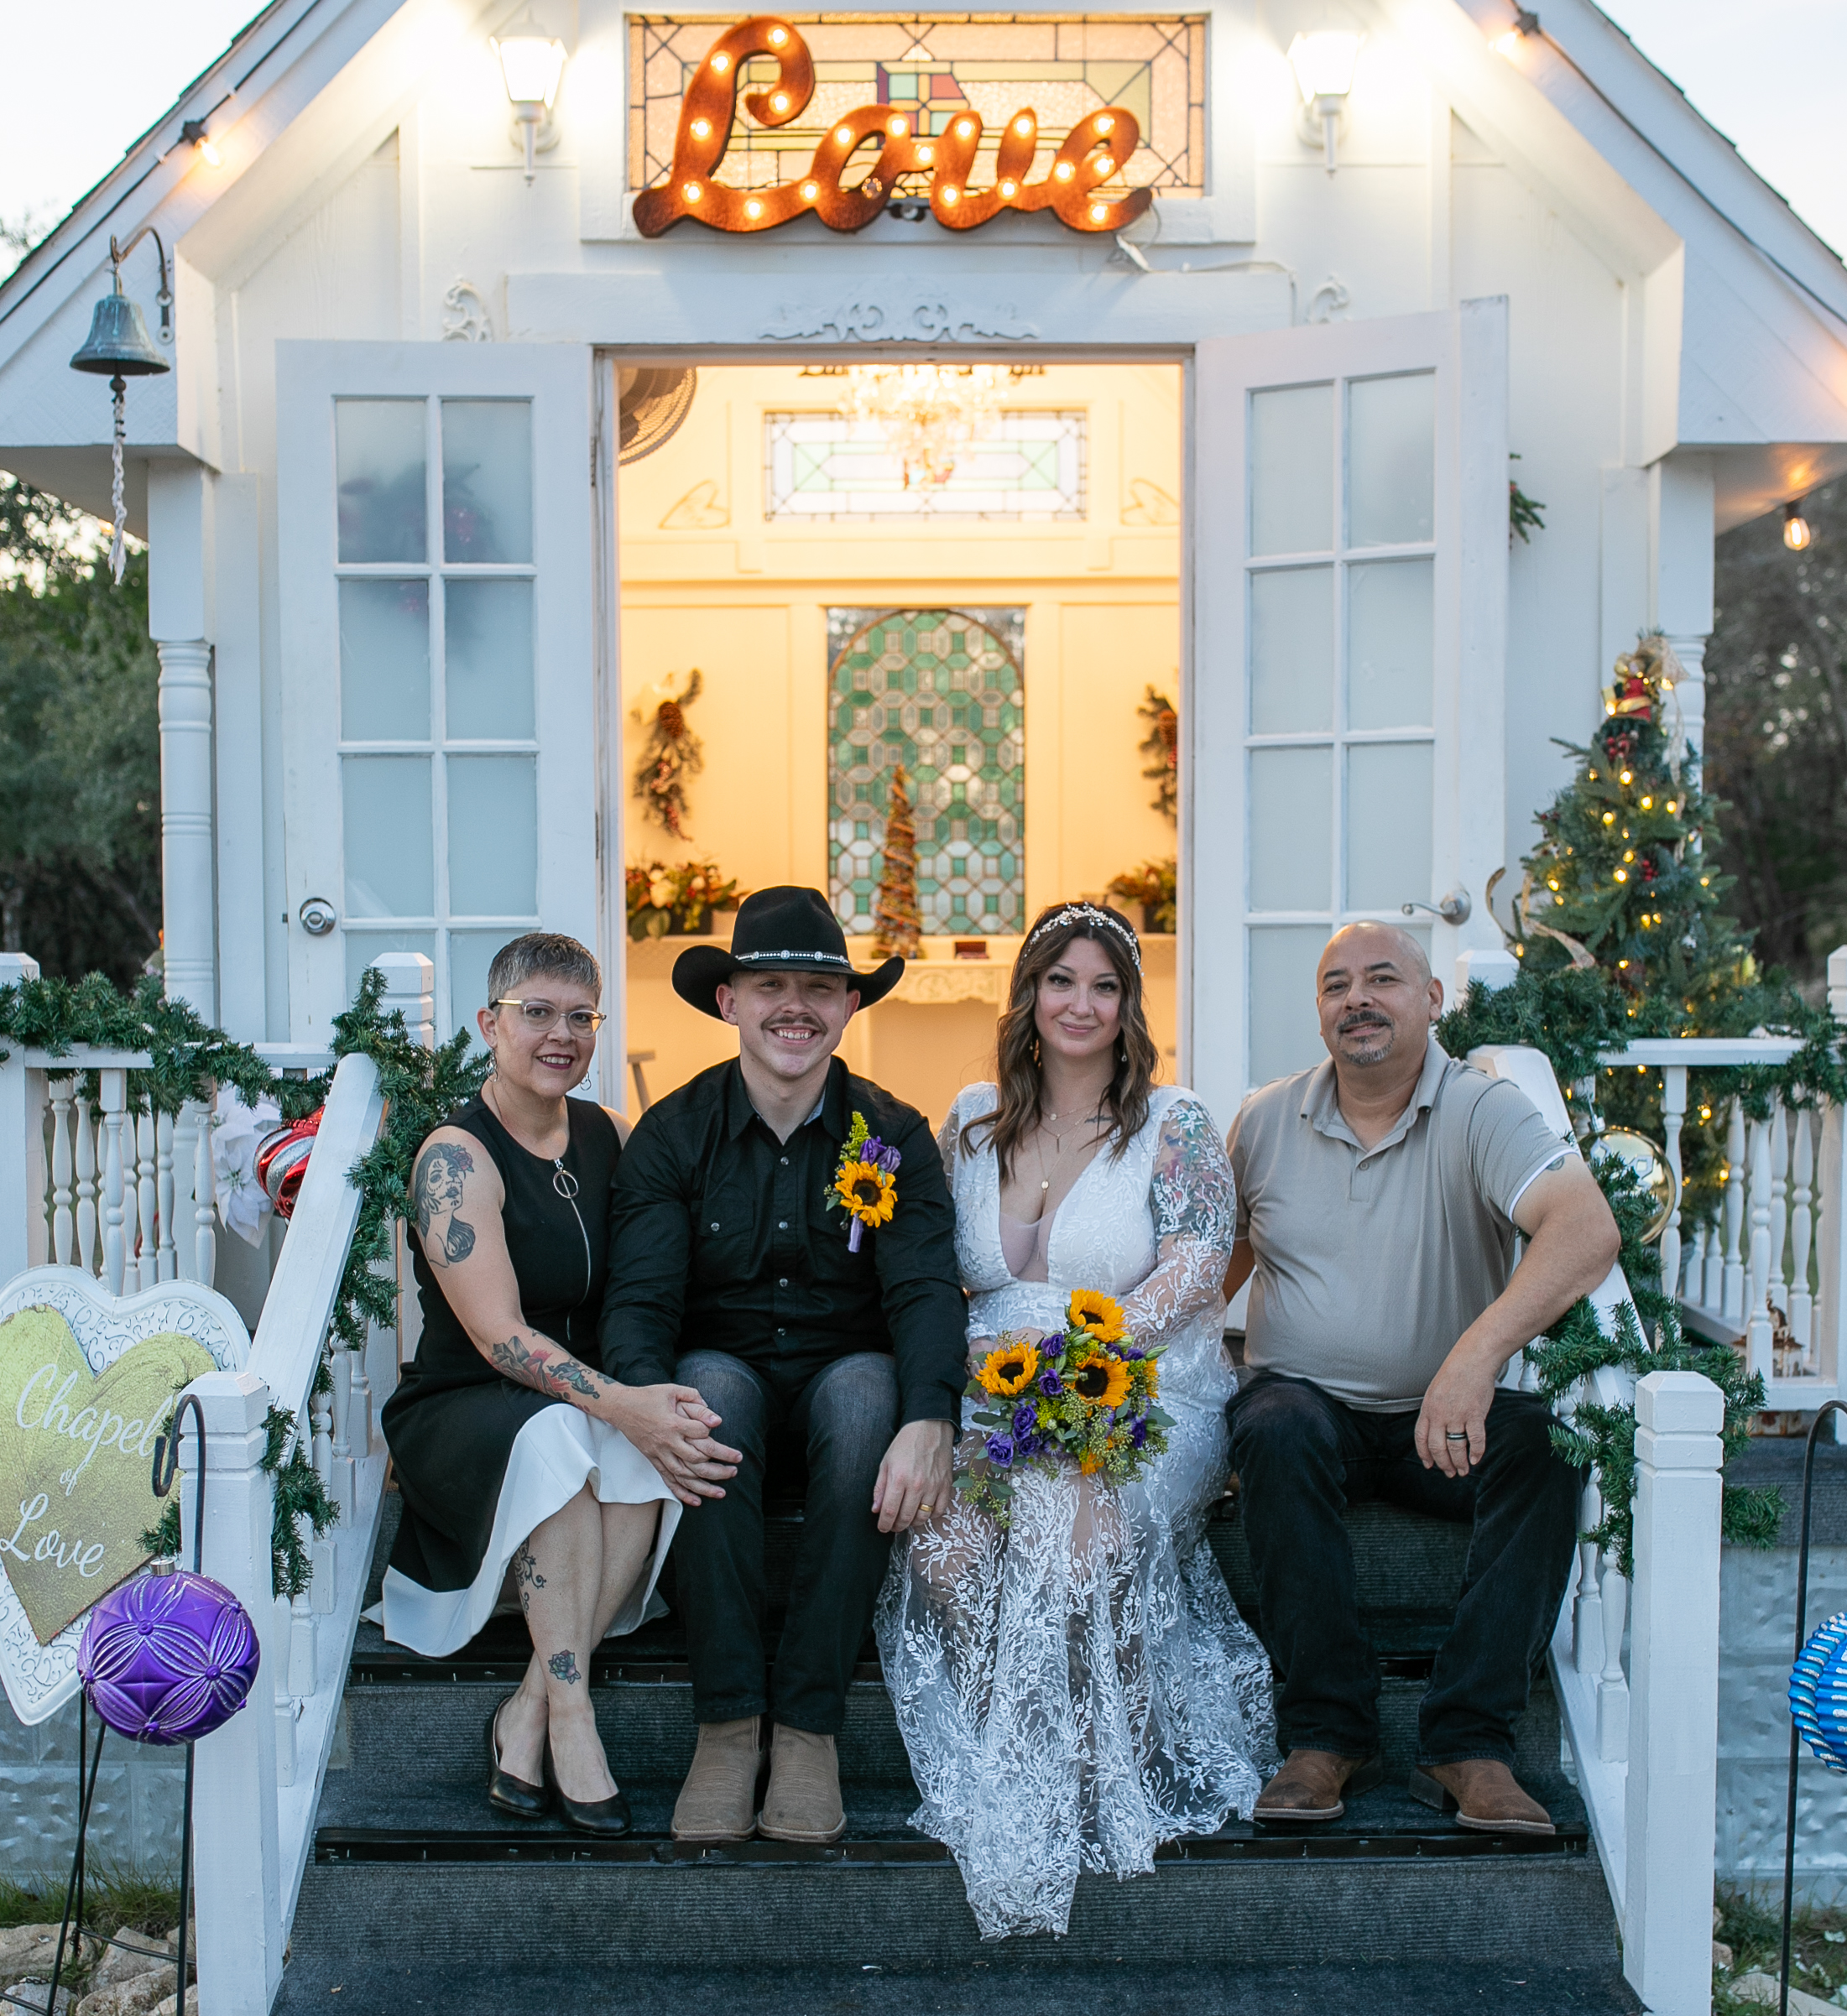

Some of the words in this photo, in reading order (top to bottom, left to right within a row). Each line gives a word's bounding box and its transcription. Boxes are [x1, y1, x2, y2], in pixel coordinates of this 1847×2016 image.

[633, 15, 1154, 238] Love
[16, 1363, 174, 1466] Chapel
[60, 1464, 86, 1496] of
[0, 1492, 106, 1578] Love
